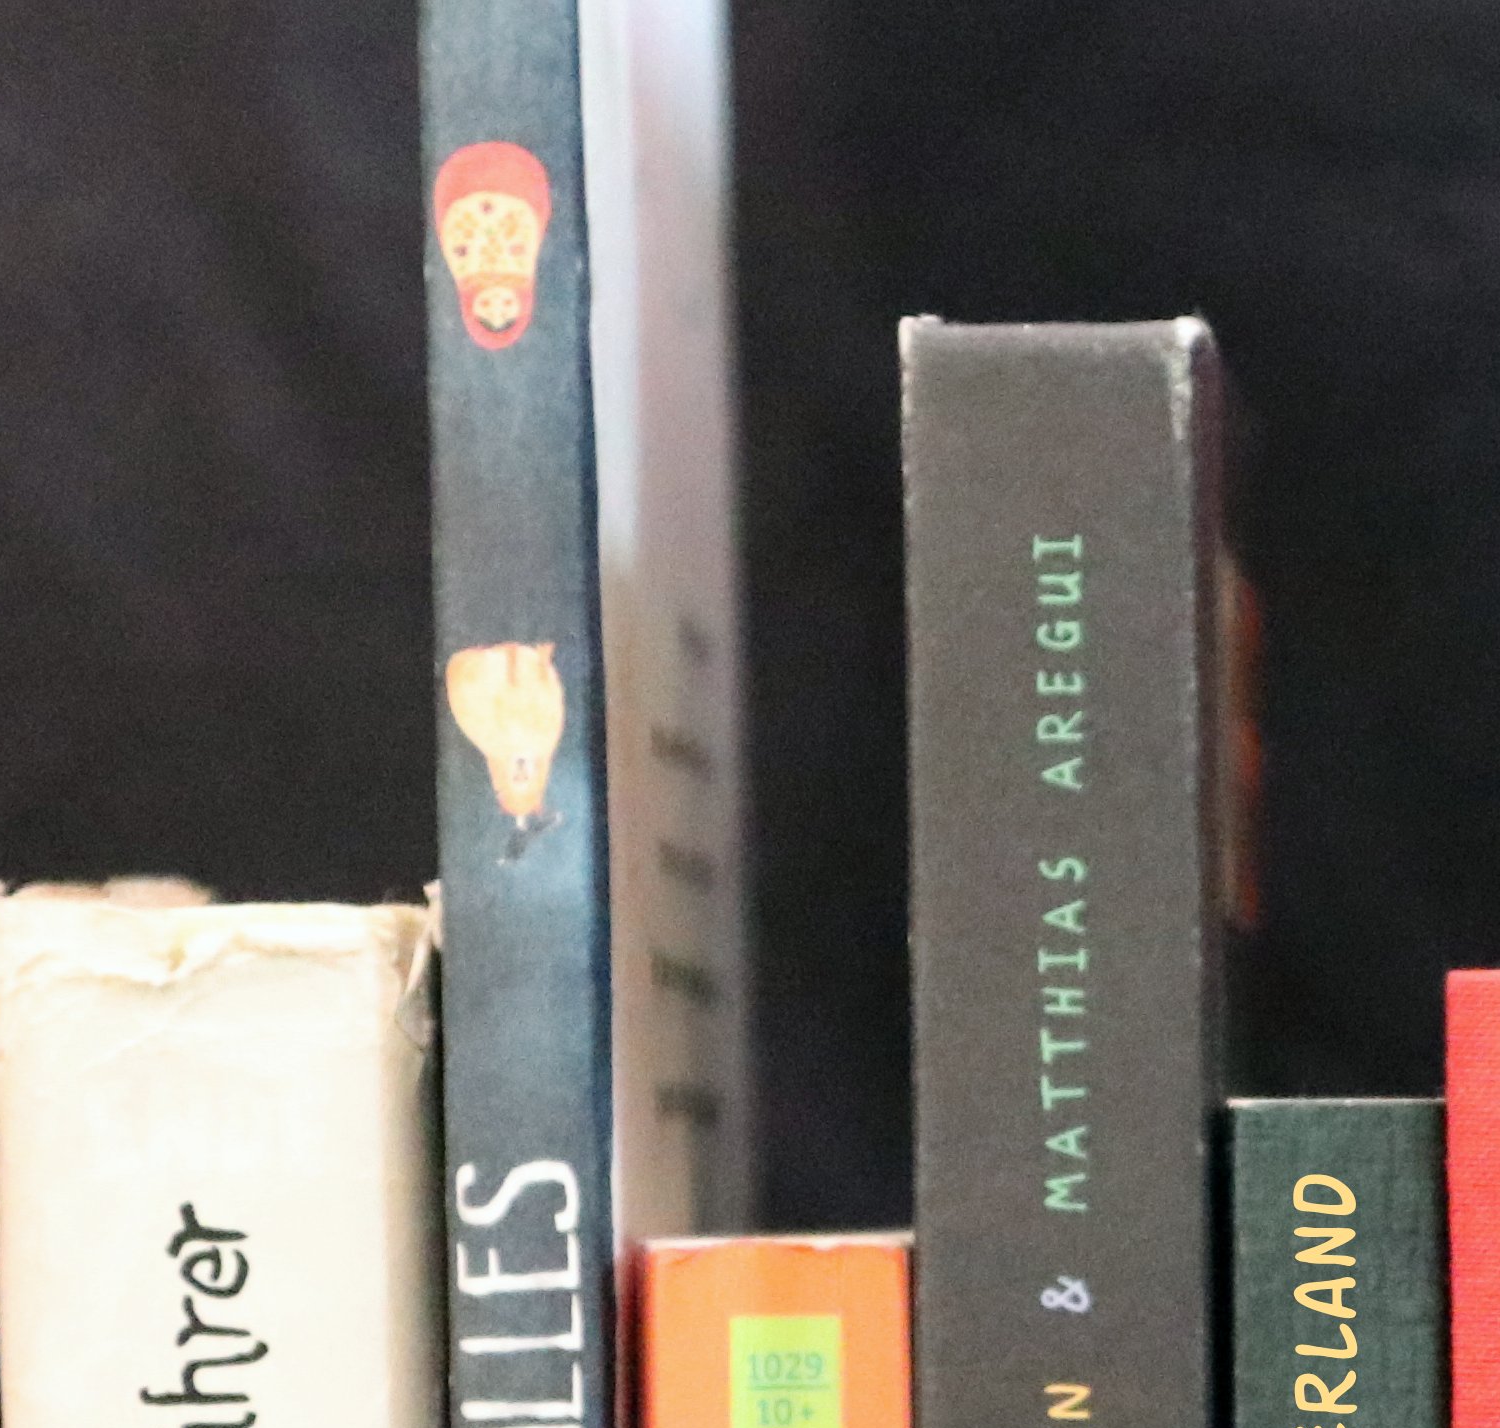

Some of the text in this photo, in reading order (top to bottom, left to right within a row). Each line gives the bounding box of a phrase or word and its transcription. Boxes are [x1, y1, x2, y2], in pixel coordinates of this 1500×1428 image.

[1033, 534, 1084, 789] AREGUI
[1039, 856, 1088, 1212] MATTHIAS
[748, 1352, 825, 1383] 1029
[1039, 1274, 1092, 1314] &
